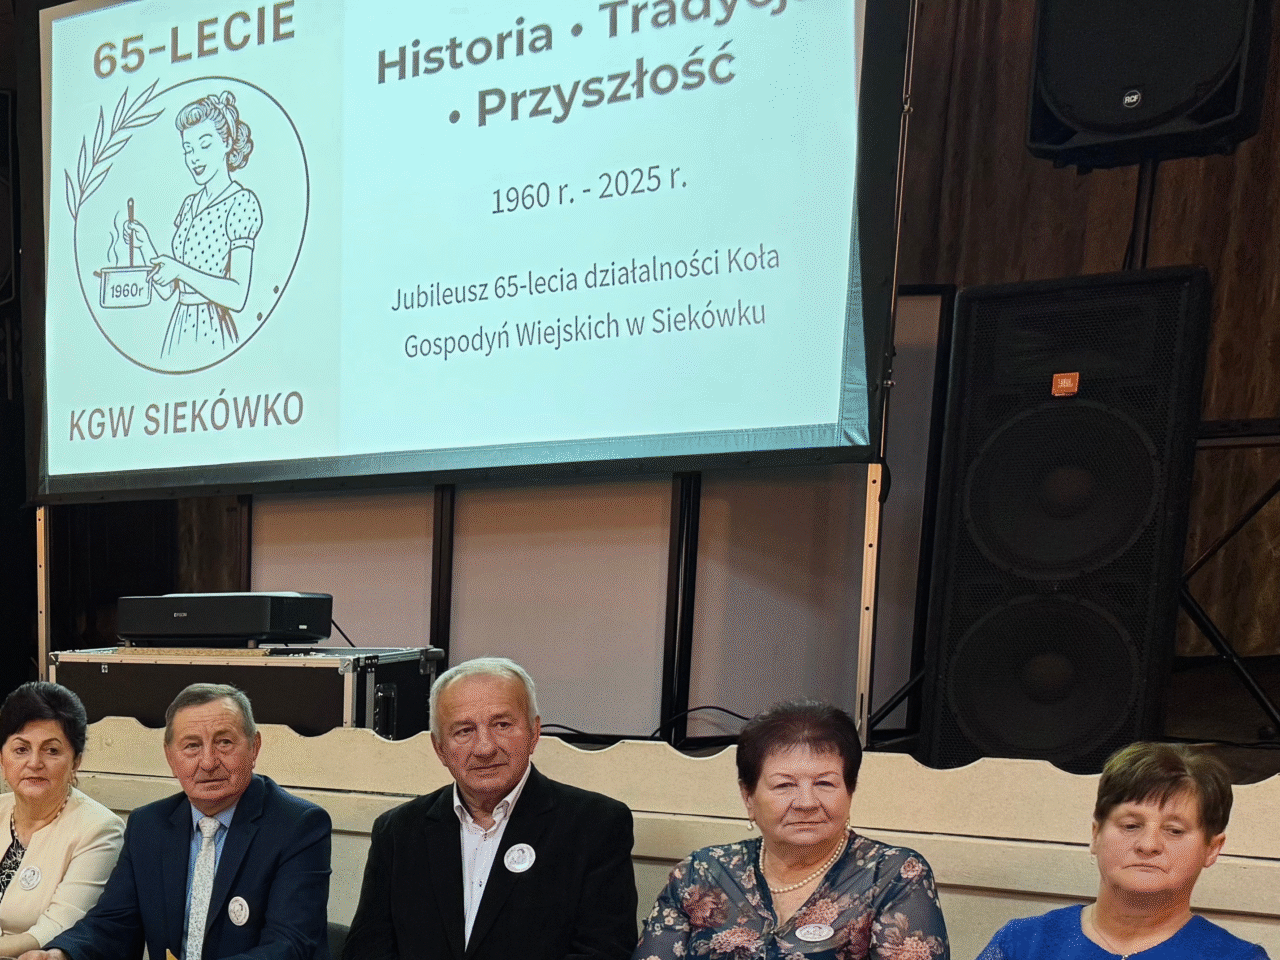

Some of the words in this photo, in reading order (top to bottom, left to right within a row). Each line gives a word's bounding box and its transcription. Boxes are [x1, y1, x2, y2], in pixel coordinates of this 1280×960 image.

[93, 0, 295, 79] 65-LECIE
[377, 16, 553, 84] Historia
[599, 0, 808, 38] Trady
[478, 39, 736, 127] Przyszłość
[1124, 94, 1139, 104] RCF
[491, 181, 550, 214] 1960
[558, 182, 575, 206] r.
[598, 165, 661, 199] 2025
[670, 167, 687, 190] r.
[110, 282, 144, 298] 1960r
[391, 279, 489, 311] Jubileusz
[494, 268, 578, 299] 65-lecia
[584, 249, 720, 289] działalności
[727, 243, 780, 274] Koła
[404, 321, 509, 361] Gospodyń
[516, 312, 619, 350] Wiejskich
[626, 316, 645, 336] w
[652, 299, 766, 334] Siekówku
[70, 405, 135, 441] KGW
[143, 388, 304, 436] SIEKÓWKO
